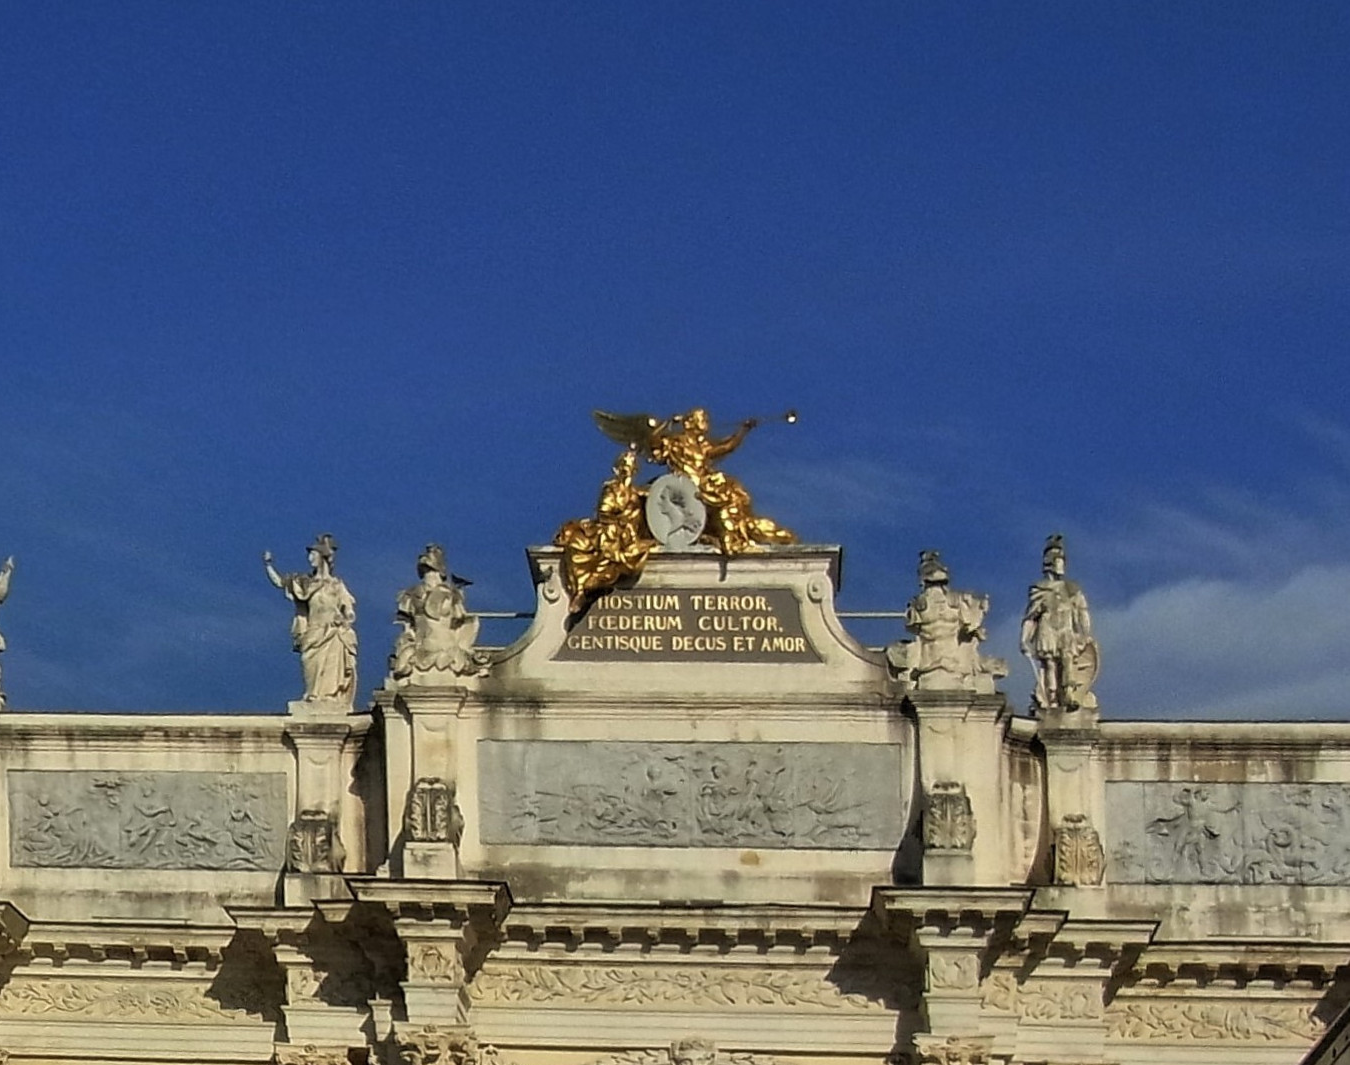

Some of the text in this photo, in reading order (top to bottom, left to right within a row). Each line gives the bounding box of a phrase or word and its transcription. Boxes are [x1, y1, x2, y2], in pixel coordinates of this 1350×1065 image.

[597, 595, 680, 610] HOSTIUM
[567, 635, 806, 653] GENTISQUE DECUS ET AMOR
